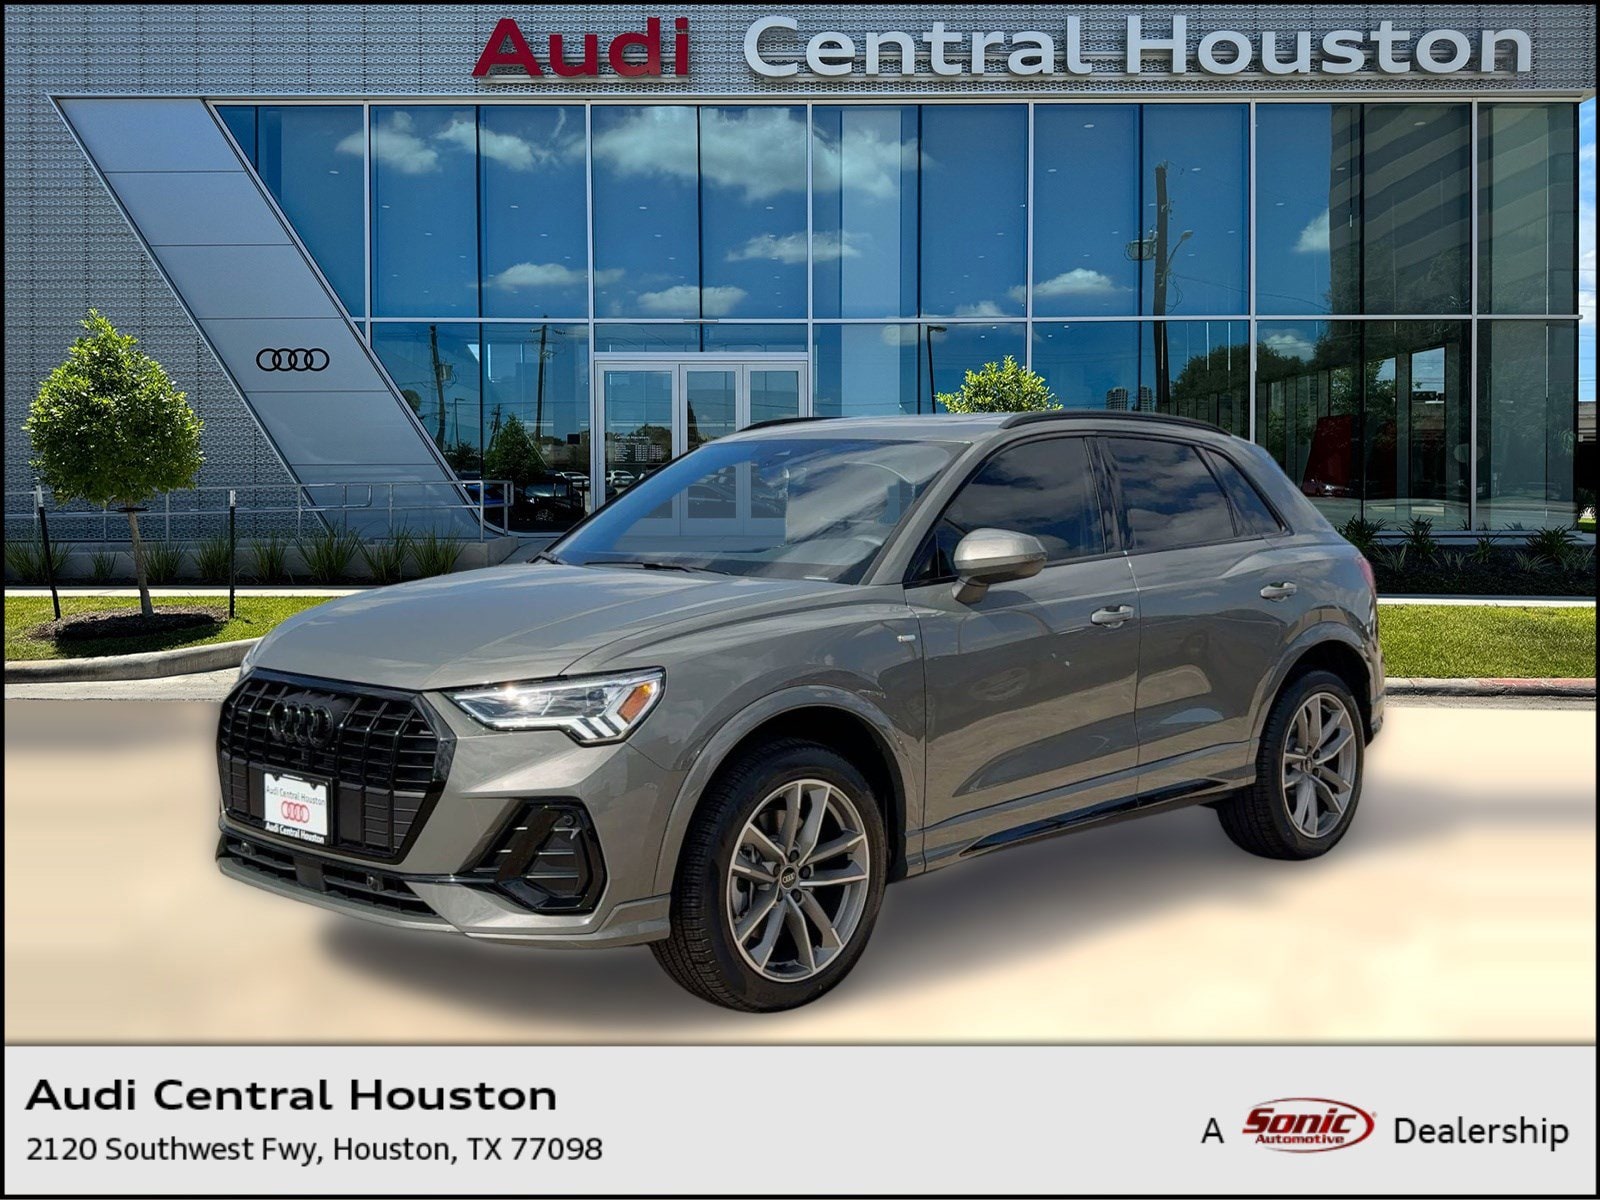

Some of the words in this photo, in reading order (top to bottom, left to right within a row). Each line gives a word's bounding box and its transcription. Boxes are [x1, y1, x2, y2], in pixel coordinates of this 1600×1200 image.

[471, 17, 688, 77] Audi
[743, 15, 1093, 77] Central
[1126, 14, 1531, 75] Houston
[266, 785, 279, 796] Audi
[280, 788, 300, 800] Central
[301, 793, 326, 806] Houston
[265, 821, 279, 834] Audi
[280, 825, 300, 839] Central
[301, 830, 325, 844] Houston
